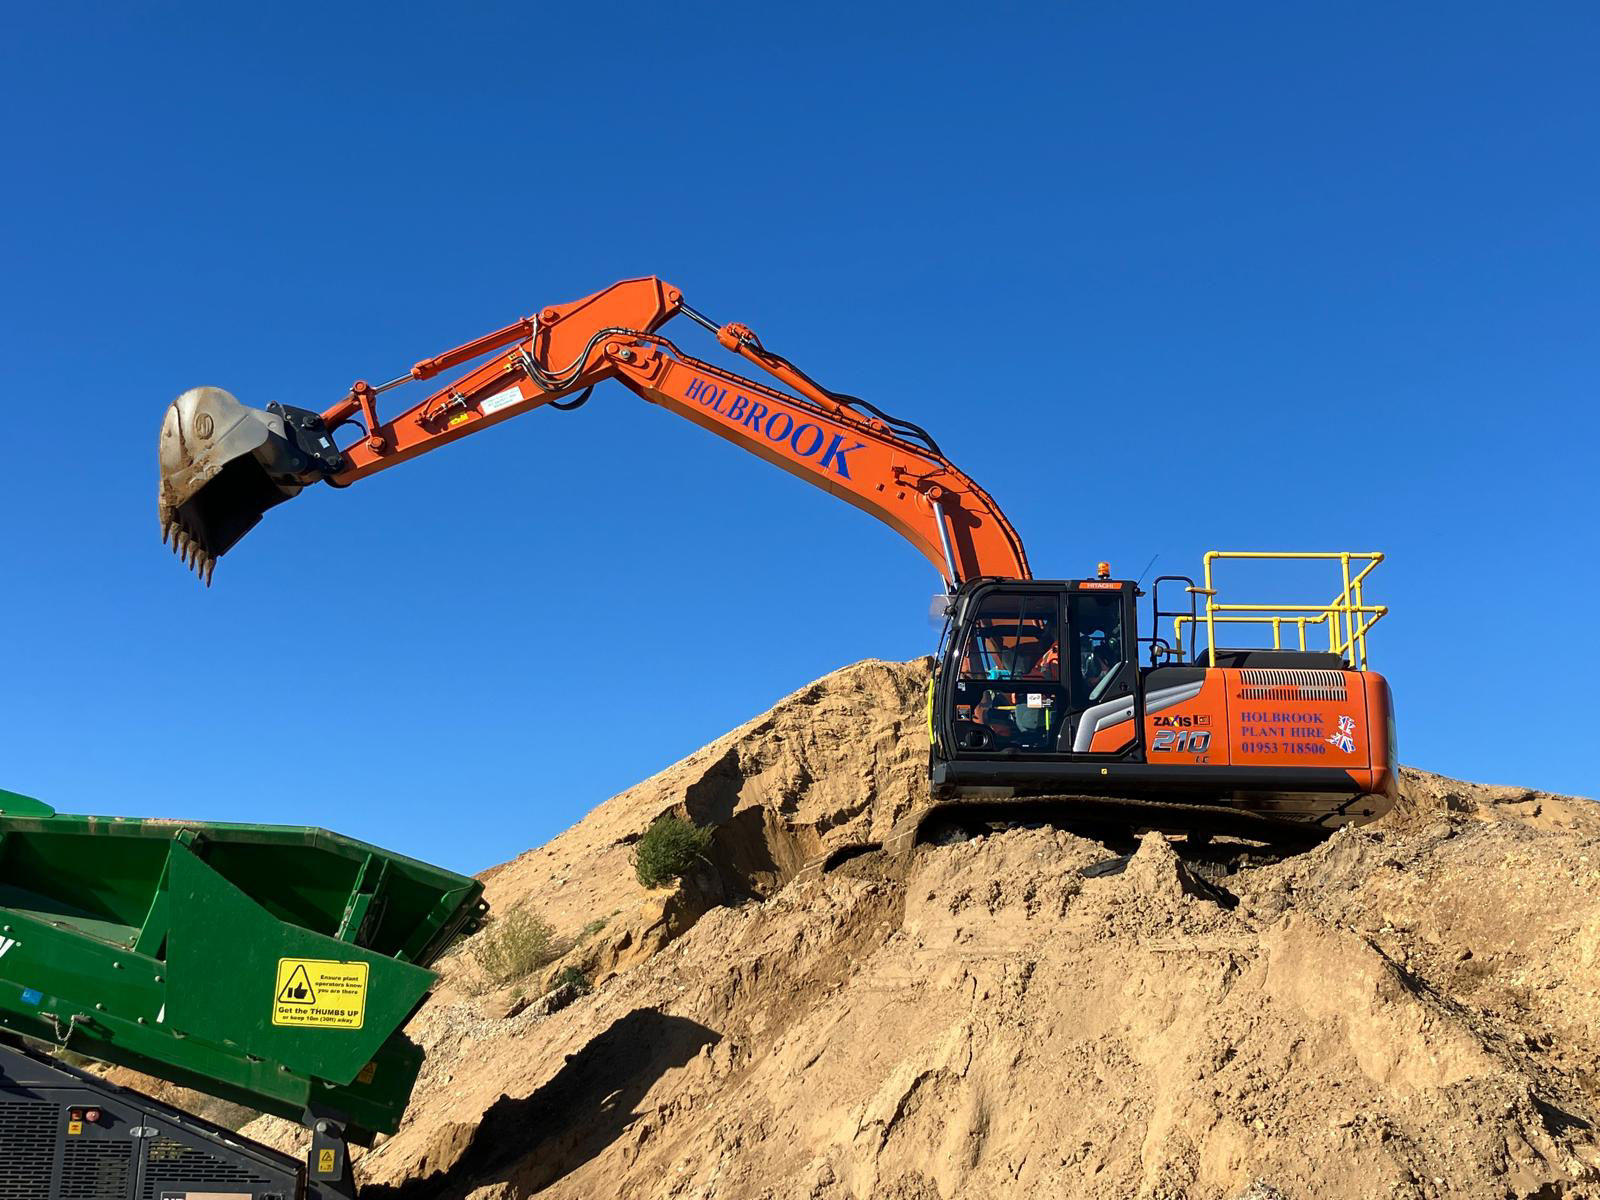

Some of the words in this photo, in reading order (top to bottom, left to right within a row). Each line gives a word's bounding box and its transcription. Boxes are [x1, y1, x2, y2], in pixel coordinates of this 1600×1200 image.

[685, 377, 868, 481] HOLBROOK
[1153, 715, 1192, 727] ZAXIS
[1241, 712, 1324, 724] HOLBROOK
[1241, 727, 1287, 737] PLANT
[1290, 728, 1325, 738] HIRE
[1152, 730, 1212, 753] 210
[1241, 742, 1279, 753] 01953
[1282, 742, 1327, 754] 718506
[278, 1006, 293, 1014] Get
[311, 1008, 345, 1016] THUMBS
